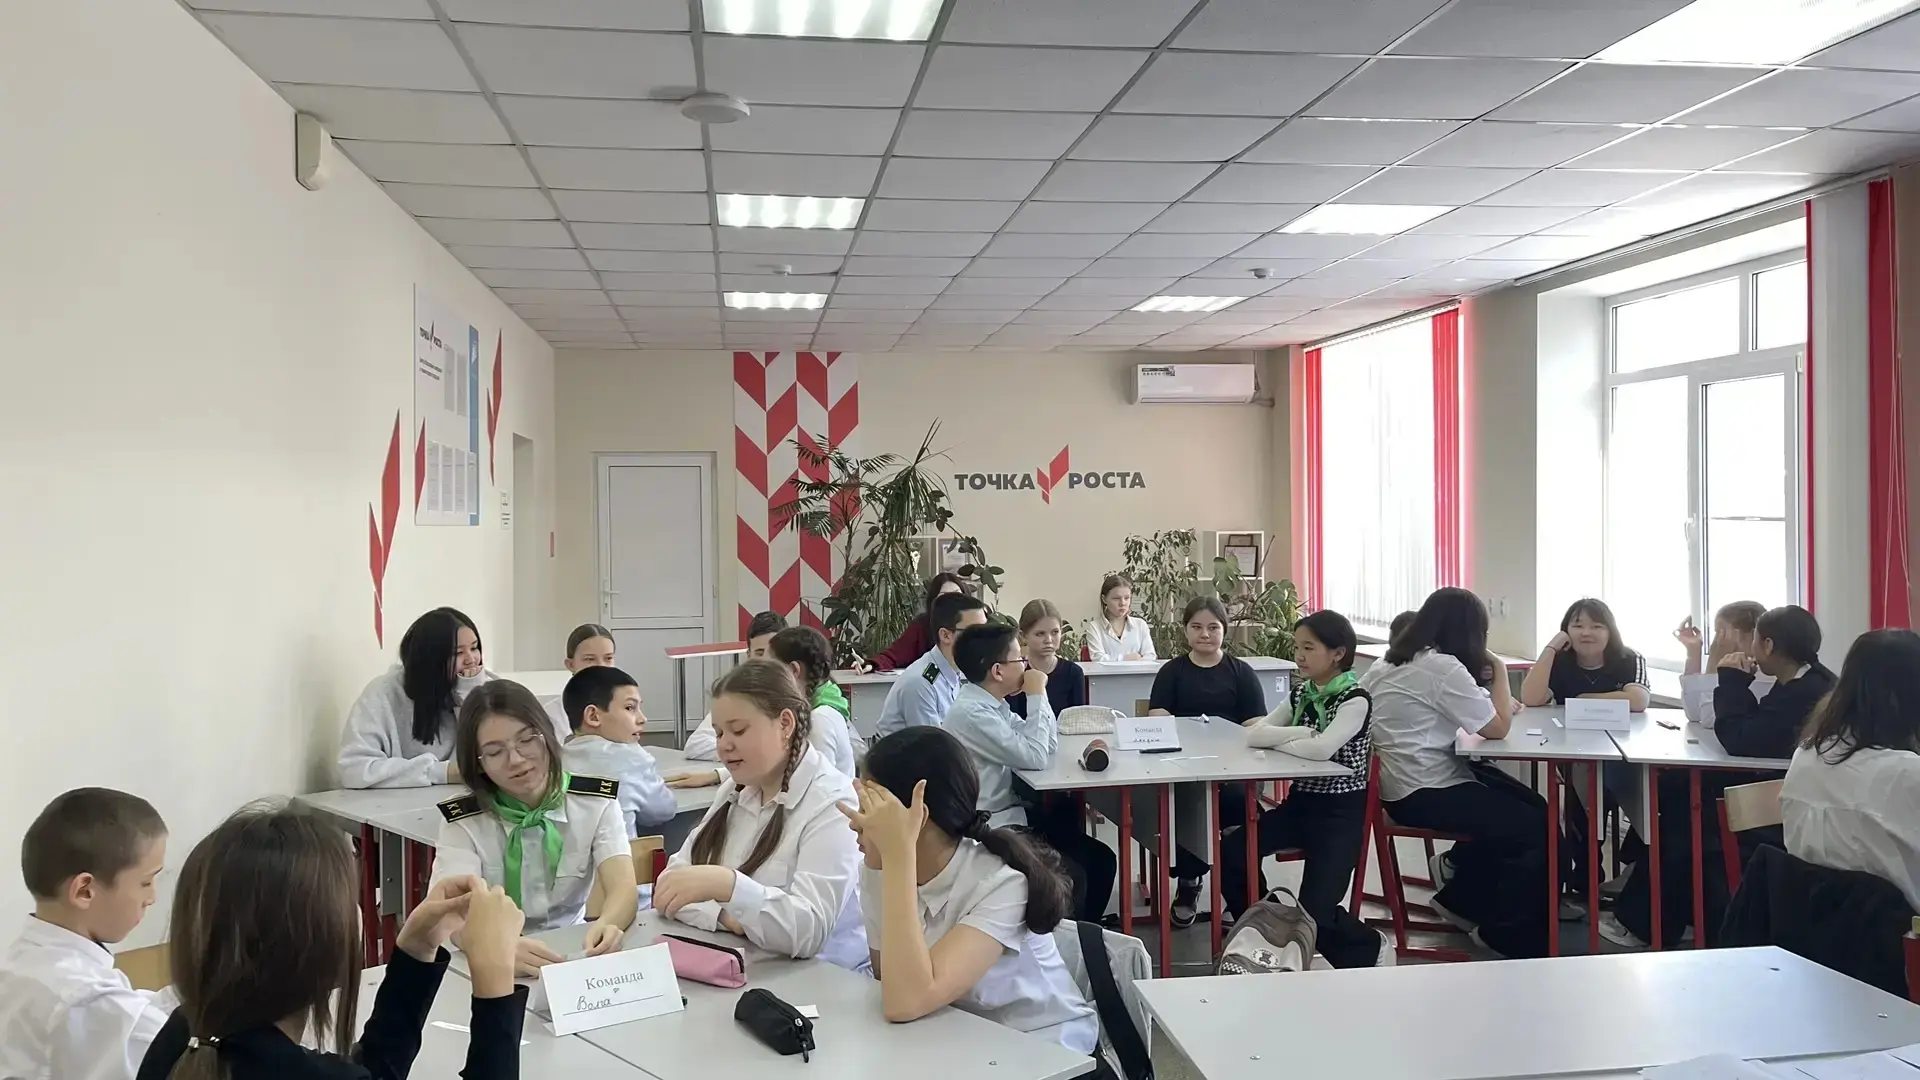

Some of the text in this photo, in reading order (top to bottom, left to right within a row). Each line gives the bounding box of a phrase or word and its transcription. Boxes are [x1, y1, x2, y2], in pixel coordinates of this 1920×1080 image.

[954, 472, 1146, 490] ТОЧКА РОСТА
[585, 971, 645, 990] Команда
